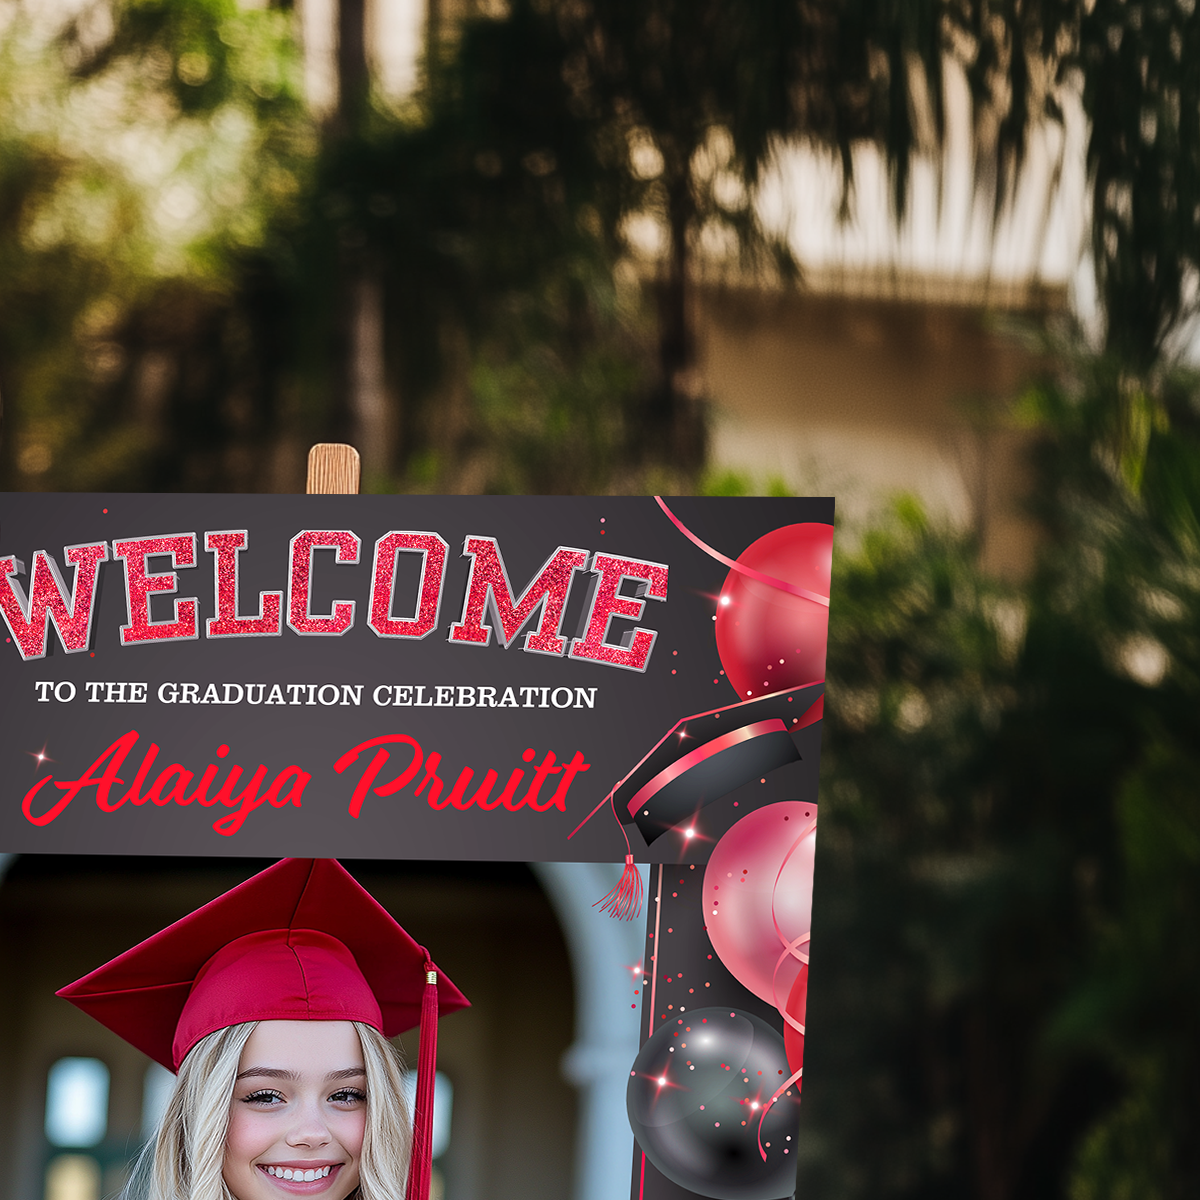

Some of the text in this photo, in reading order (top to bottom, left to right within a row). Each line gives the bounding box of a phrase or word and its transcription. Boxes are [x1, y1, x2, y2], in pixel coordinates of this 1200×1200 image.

[34, 681, 598, 709] TO THE GRADUATION CELEBRATION
[21, 729, 592, 837] Alaiya Pruitt
